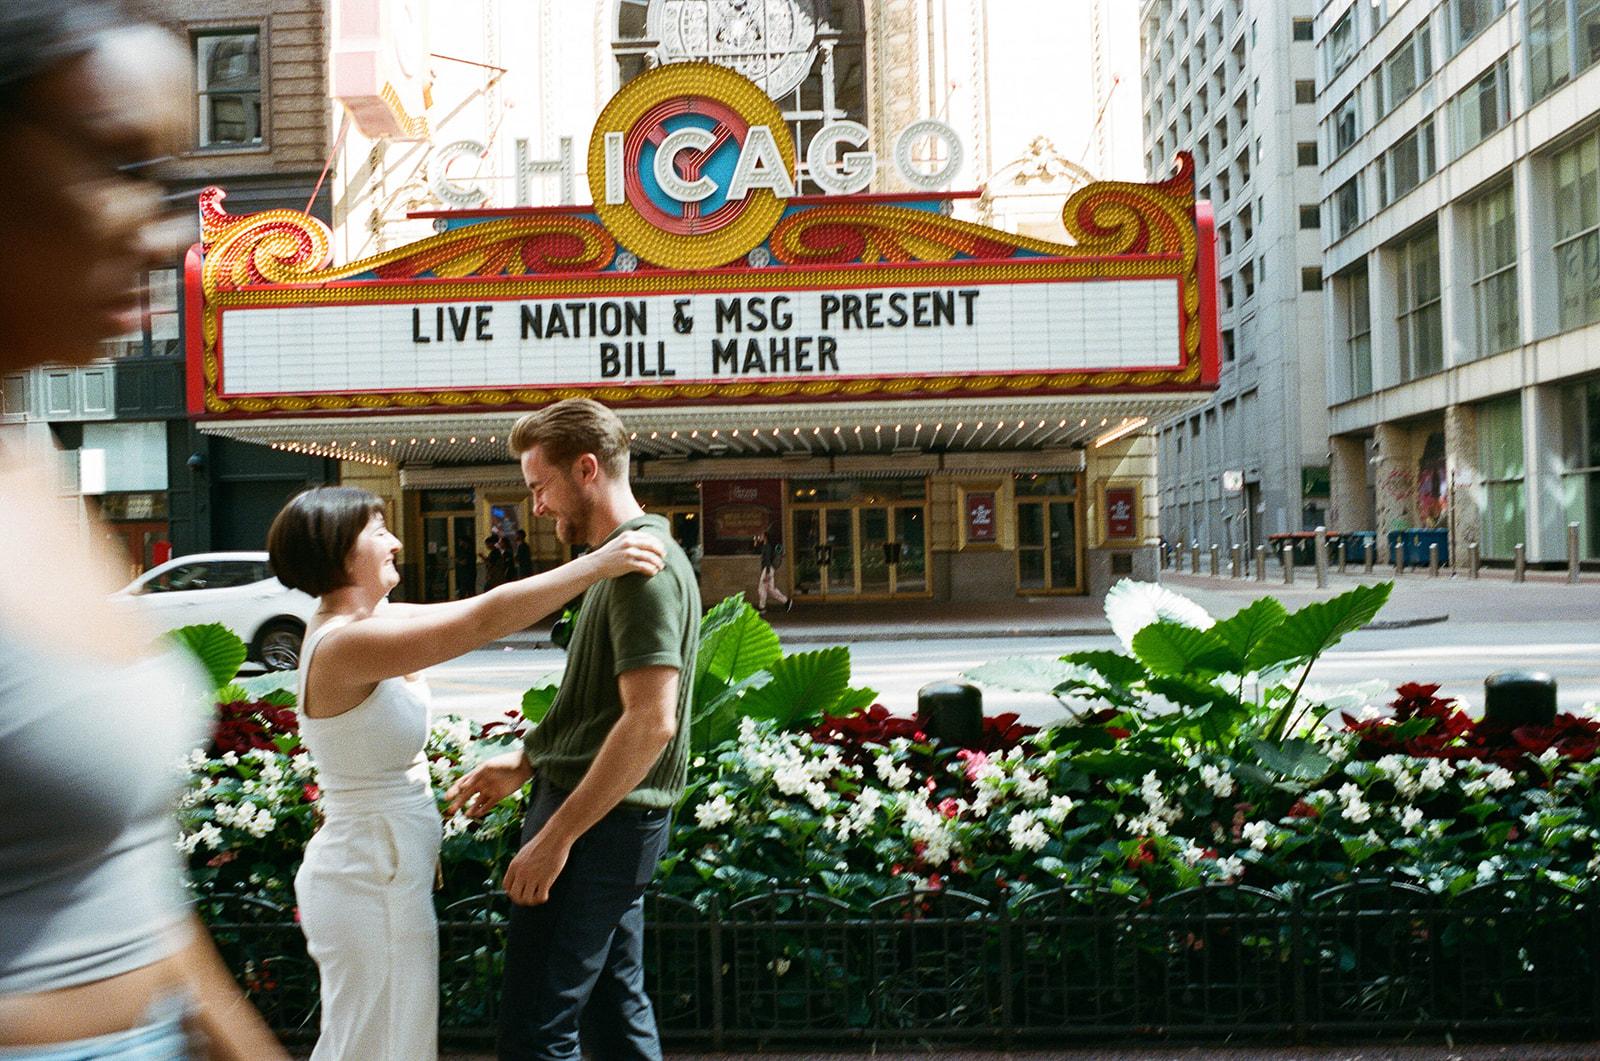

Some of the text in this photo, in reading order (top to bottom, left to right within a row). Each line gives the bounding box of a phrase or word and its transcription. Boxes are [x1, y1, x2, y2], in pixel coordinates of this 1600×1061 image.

[429, 118, 964, 208] CHICAGO
[412, 290, 980, 344] LIVE NATION & MSG PRESENT
[600, 335, 839, 378] BILL MAHER
